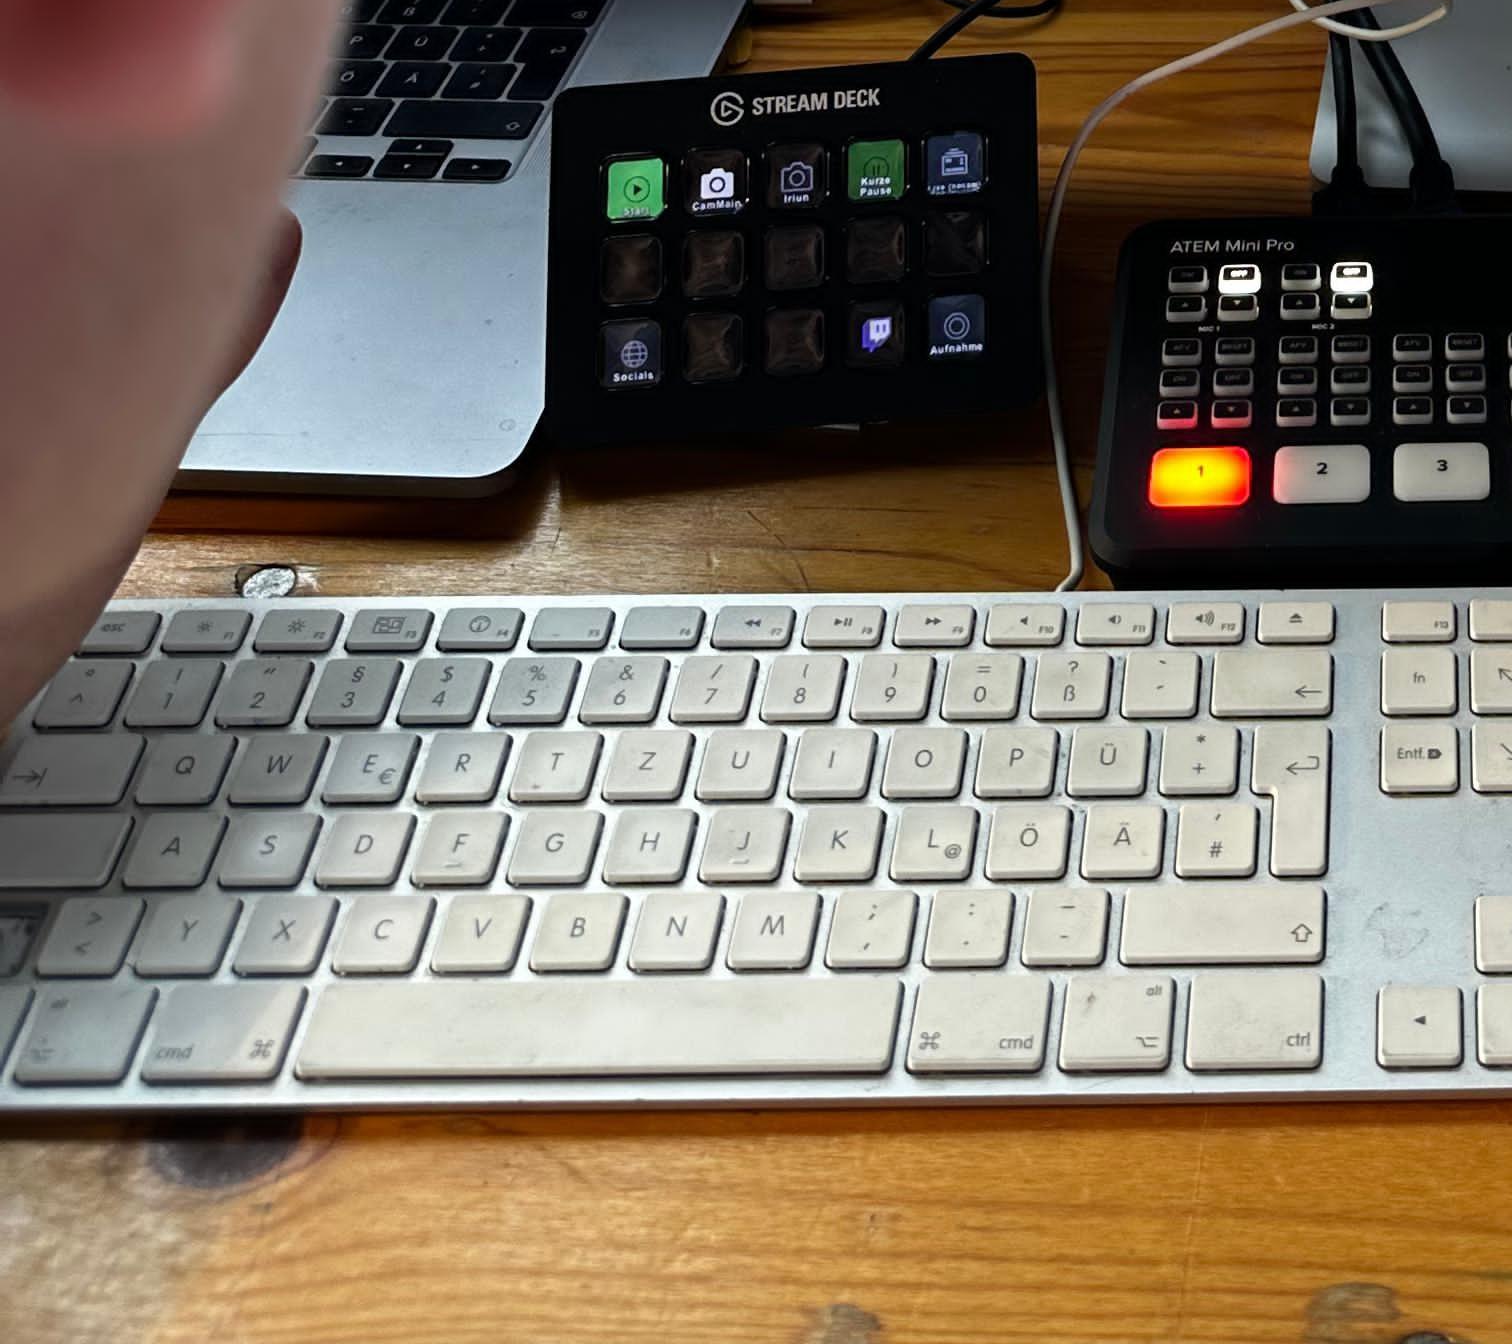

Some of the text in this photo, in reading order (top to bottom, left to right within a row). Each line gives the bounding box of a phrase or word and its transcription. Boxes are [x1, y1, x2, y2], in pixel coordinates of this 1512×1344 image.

[751, 88, 881, 116] STREAM DECK
[860, 185, 892, 196] Pause
[1170, 239, 1295, 254] ATEM Mini Pro
[929, 341, 984, 356] Aufnahme
[613, 370, 654, 383] Socials
[1315, 462, 1328, 475] 2
[1436, 459, 1448, 472] 3
[1412, 671, 1426, 685] fn
[1396, 746, 1426, 761] Entf.
[998, 1034, 1034, 1051] cmd
[1285, 1032, 1311, 1050] ctrl
